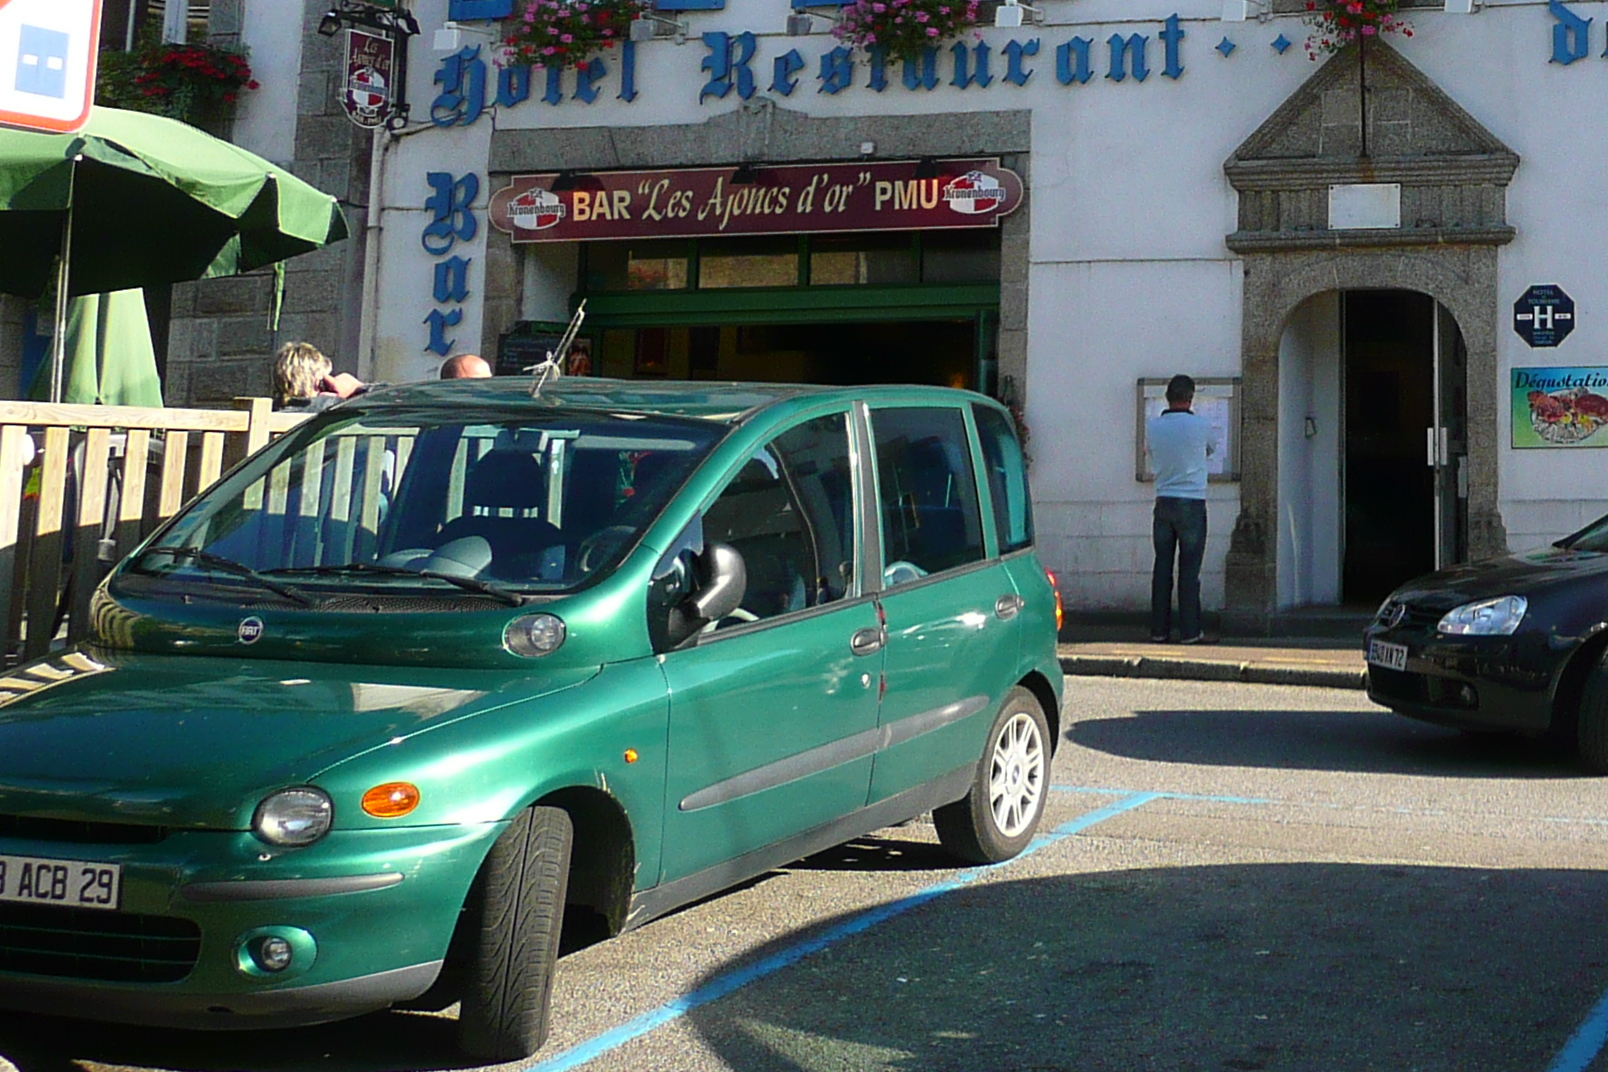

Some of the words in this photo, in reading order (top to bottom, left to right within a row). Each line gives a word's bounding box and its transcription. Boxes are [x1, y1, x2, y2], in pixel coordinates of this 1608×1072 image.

[700, 13, 1186, 106] Restaurant
[573, 190, 631, 221] BAR
[698, 176, 790, 230] Ajoncs
[875, 179, 938, 211] PMU
[942, 184, 1006, 202] Kronenbourg
[507, 201, 566, 218] Kronenbourg
[422, 171, 479, 356] Bar
[1533, 305, 1553, 329] H
[242, 626, 260, 635] FIAT
[18, 863, 68, 900] ACB
[79, 868, 114, 904] 29
